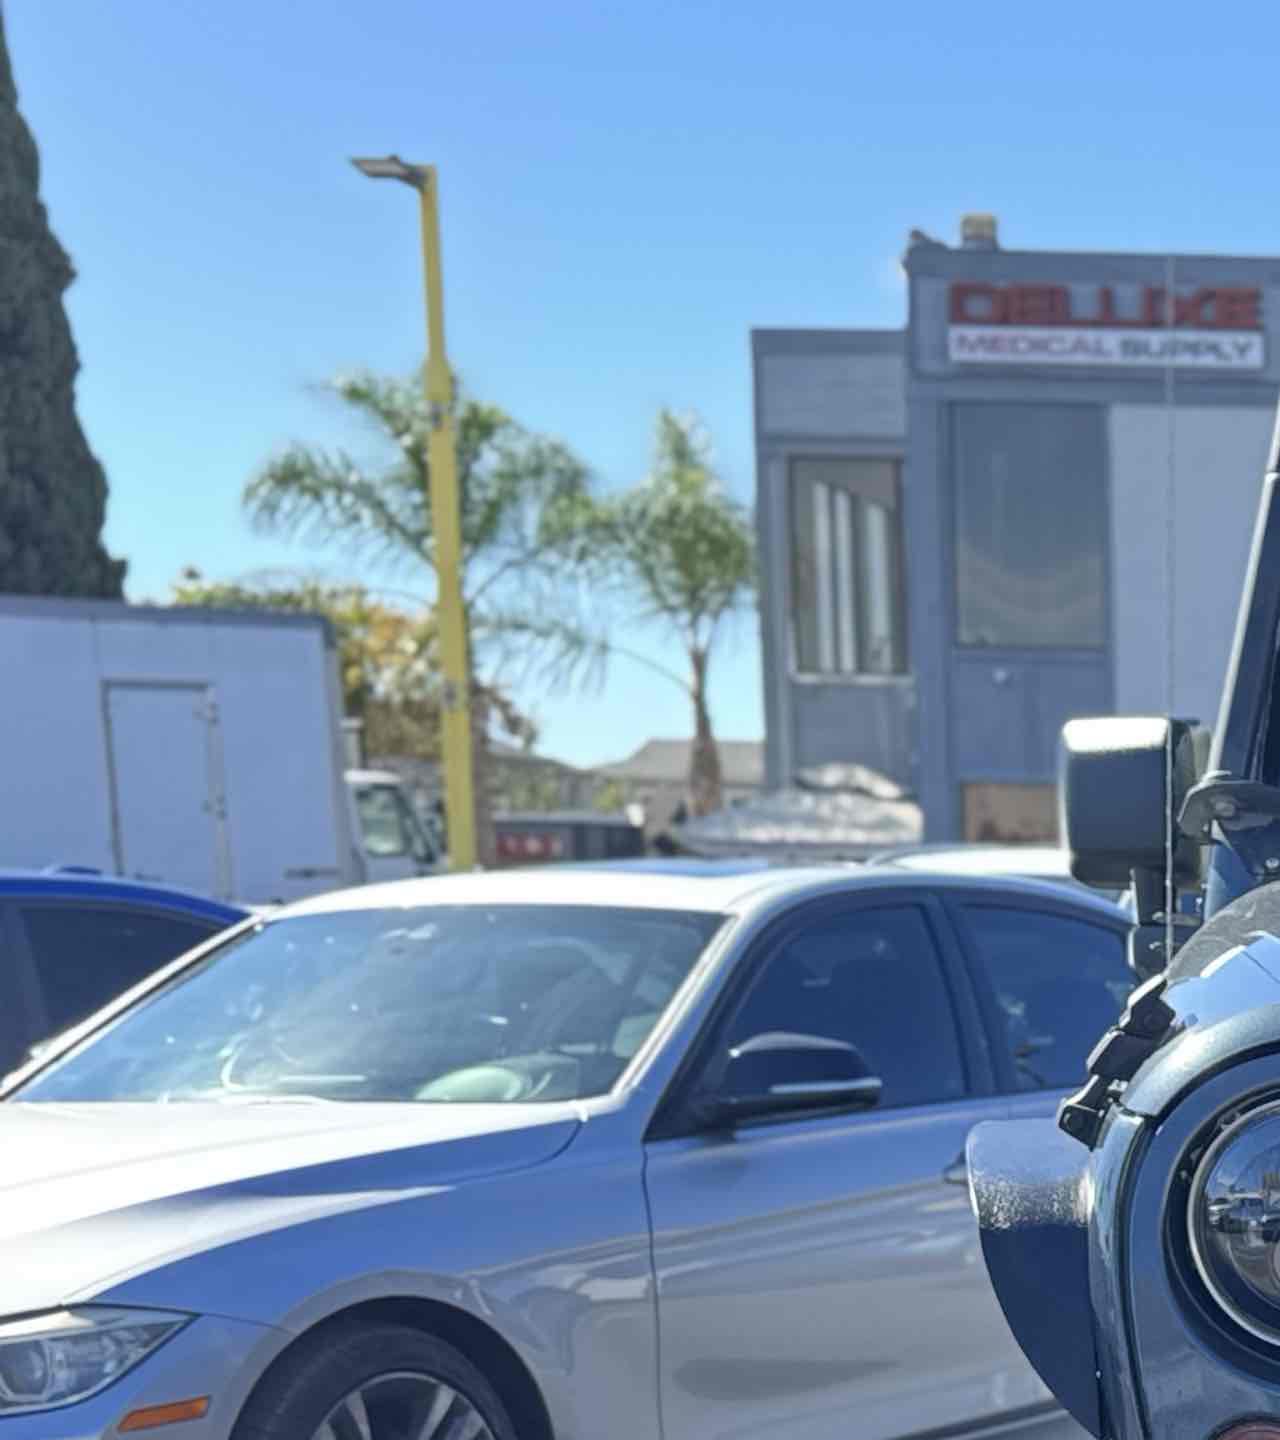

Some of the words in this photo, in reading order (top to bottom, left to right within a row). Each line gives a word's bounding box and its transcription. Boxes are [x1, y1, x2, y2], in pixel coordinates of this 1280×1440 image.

[950, 284, 1261, 326] DELUXE
[956, 333, 1111, 355] MEDICAL
[1120, 338, 1253, 359] SUPPLY
